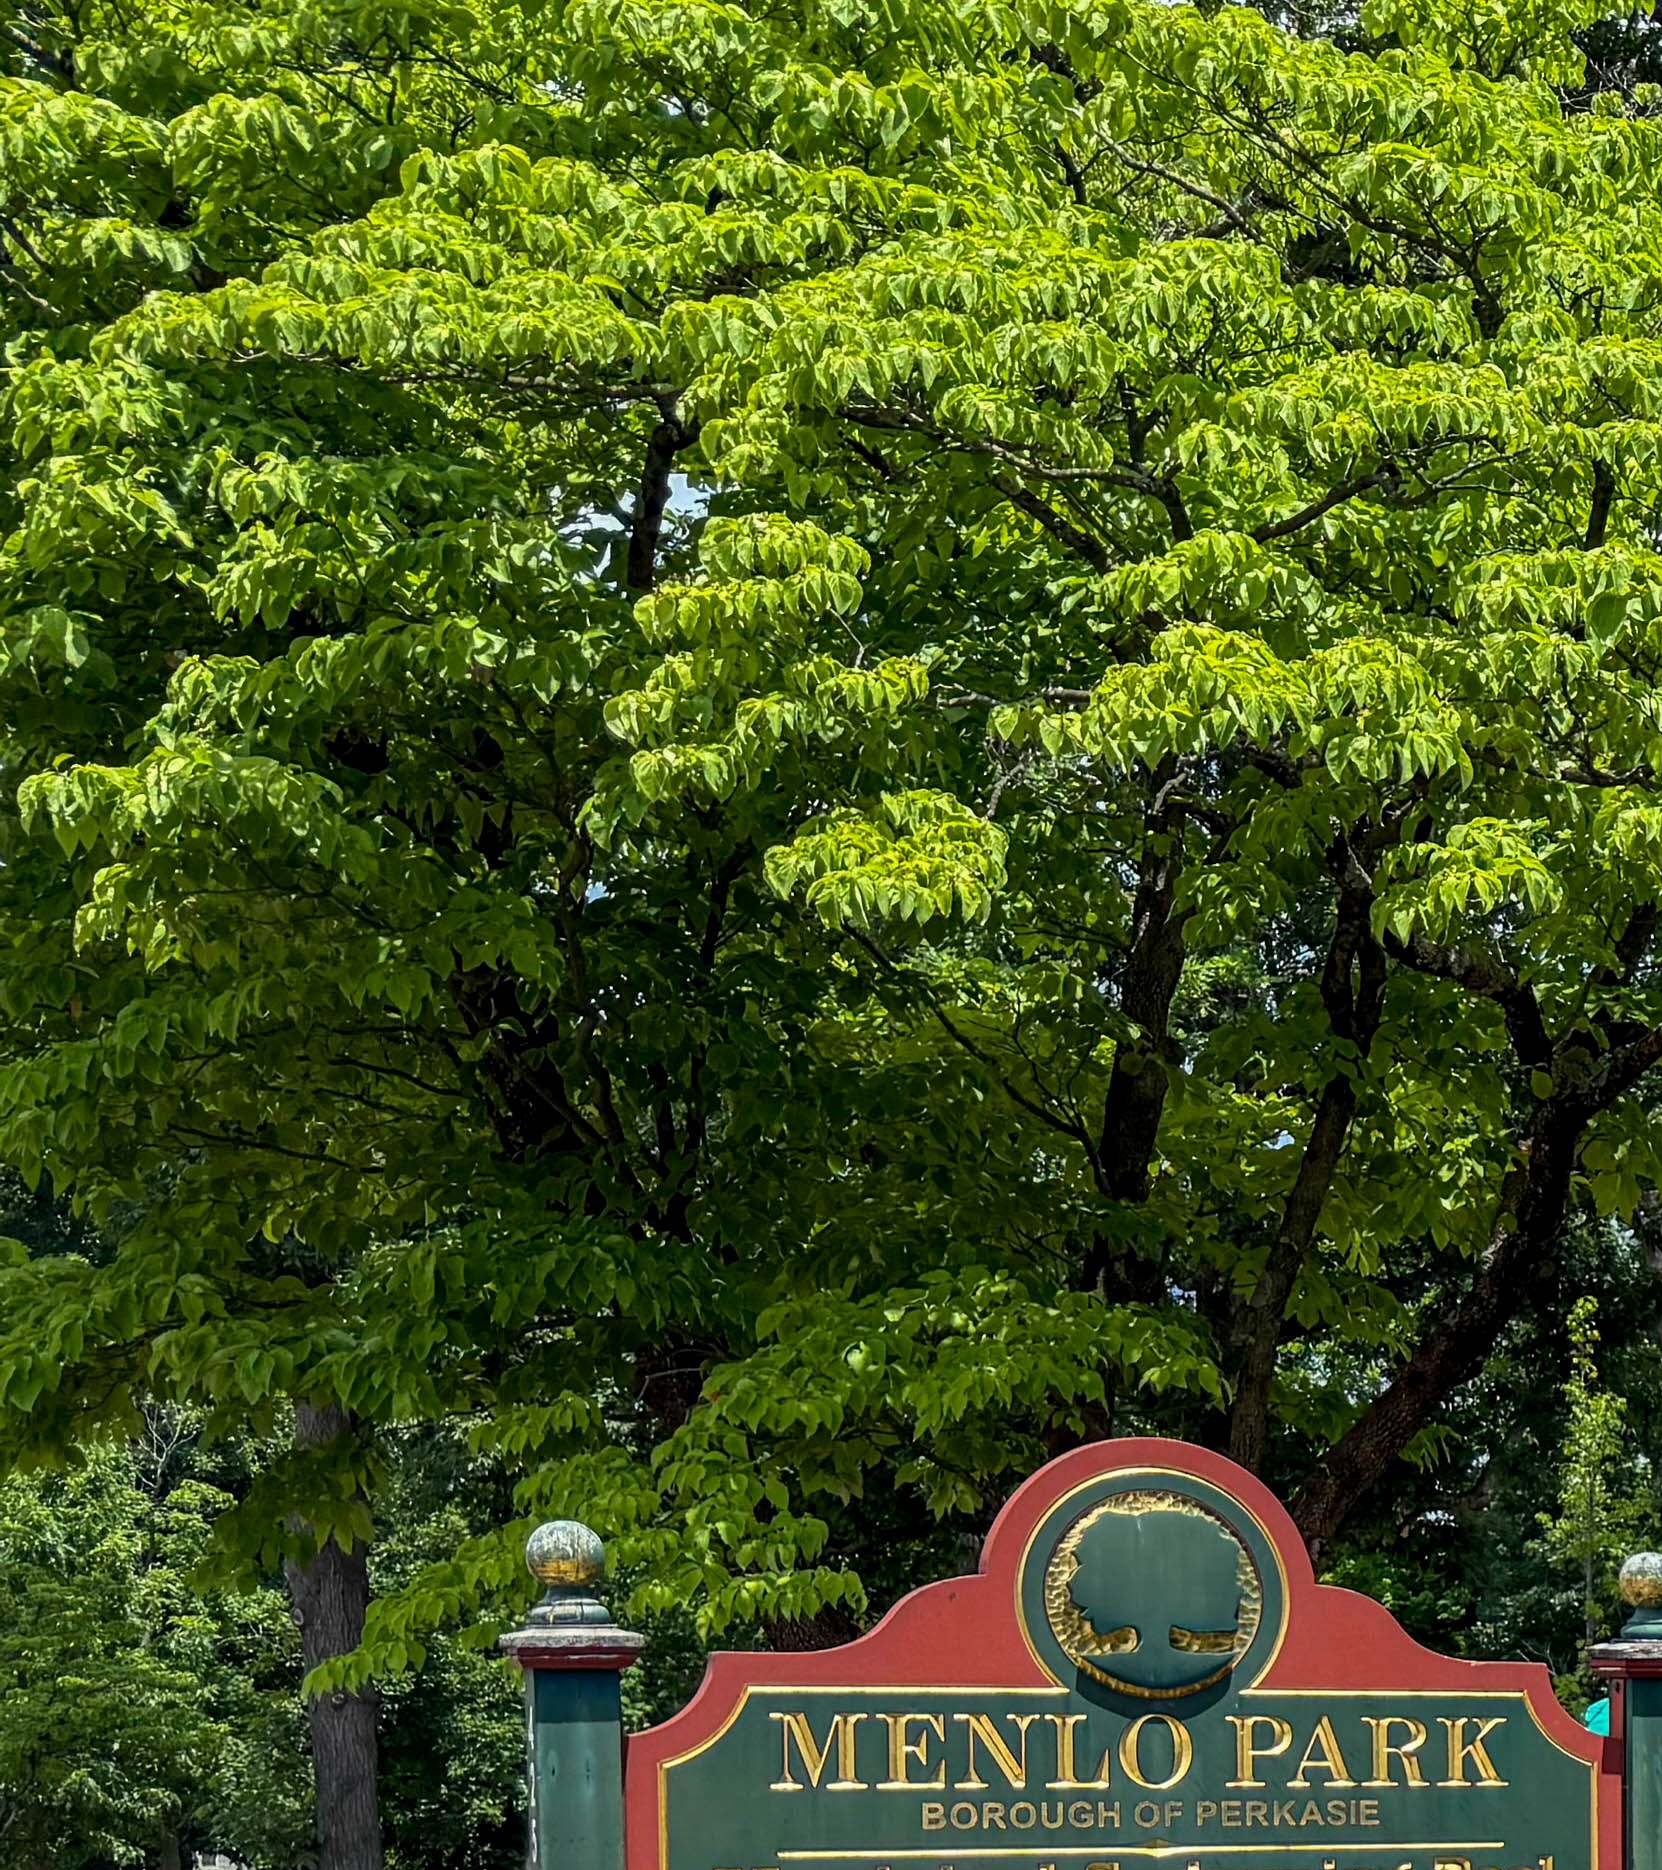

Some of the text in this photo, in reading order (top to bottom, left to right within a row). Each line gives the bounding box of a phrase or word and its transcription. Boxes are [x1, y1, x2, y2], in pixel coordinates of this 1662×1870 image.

[769, 1711, 1510, 1791] MENLO PARK
[920, 1798, 1381, 1831] BOROUGH OF PERKASIE
